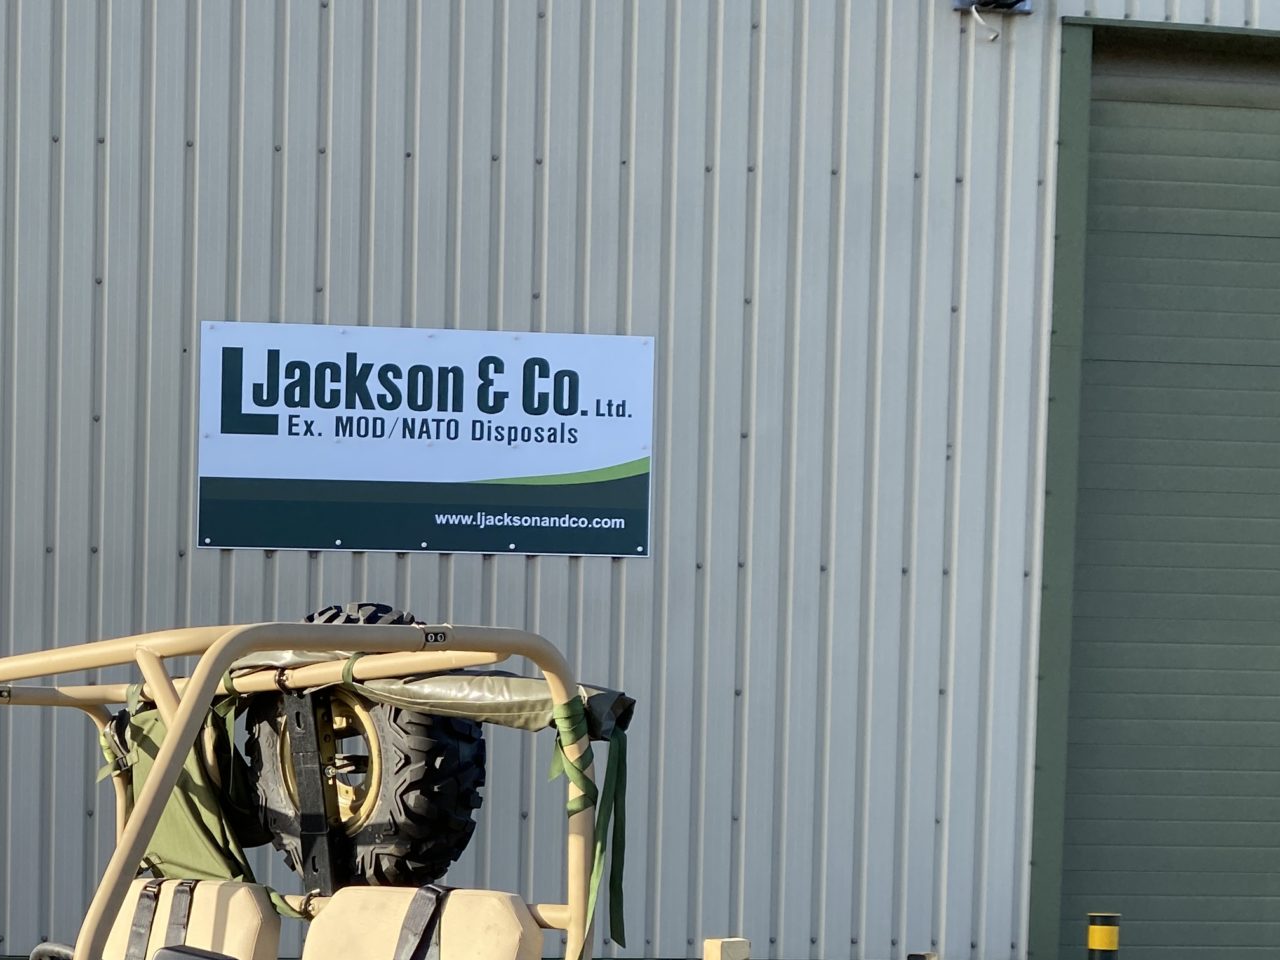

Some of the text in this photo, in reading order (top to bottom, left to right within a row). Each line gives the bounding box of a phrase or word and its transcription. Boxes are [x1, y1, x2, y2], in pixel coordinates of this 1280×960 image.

[477, 355, 509, 415] &
[522, 357, 588, 417] Co.
[595, 399, 632, 418] Ltd.
[287, 414, 578, 446] Ex. MOD/NATO Disposals
[435, 511, 625, 529] www.ljacksonandco.com
